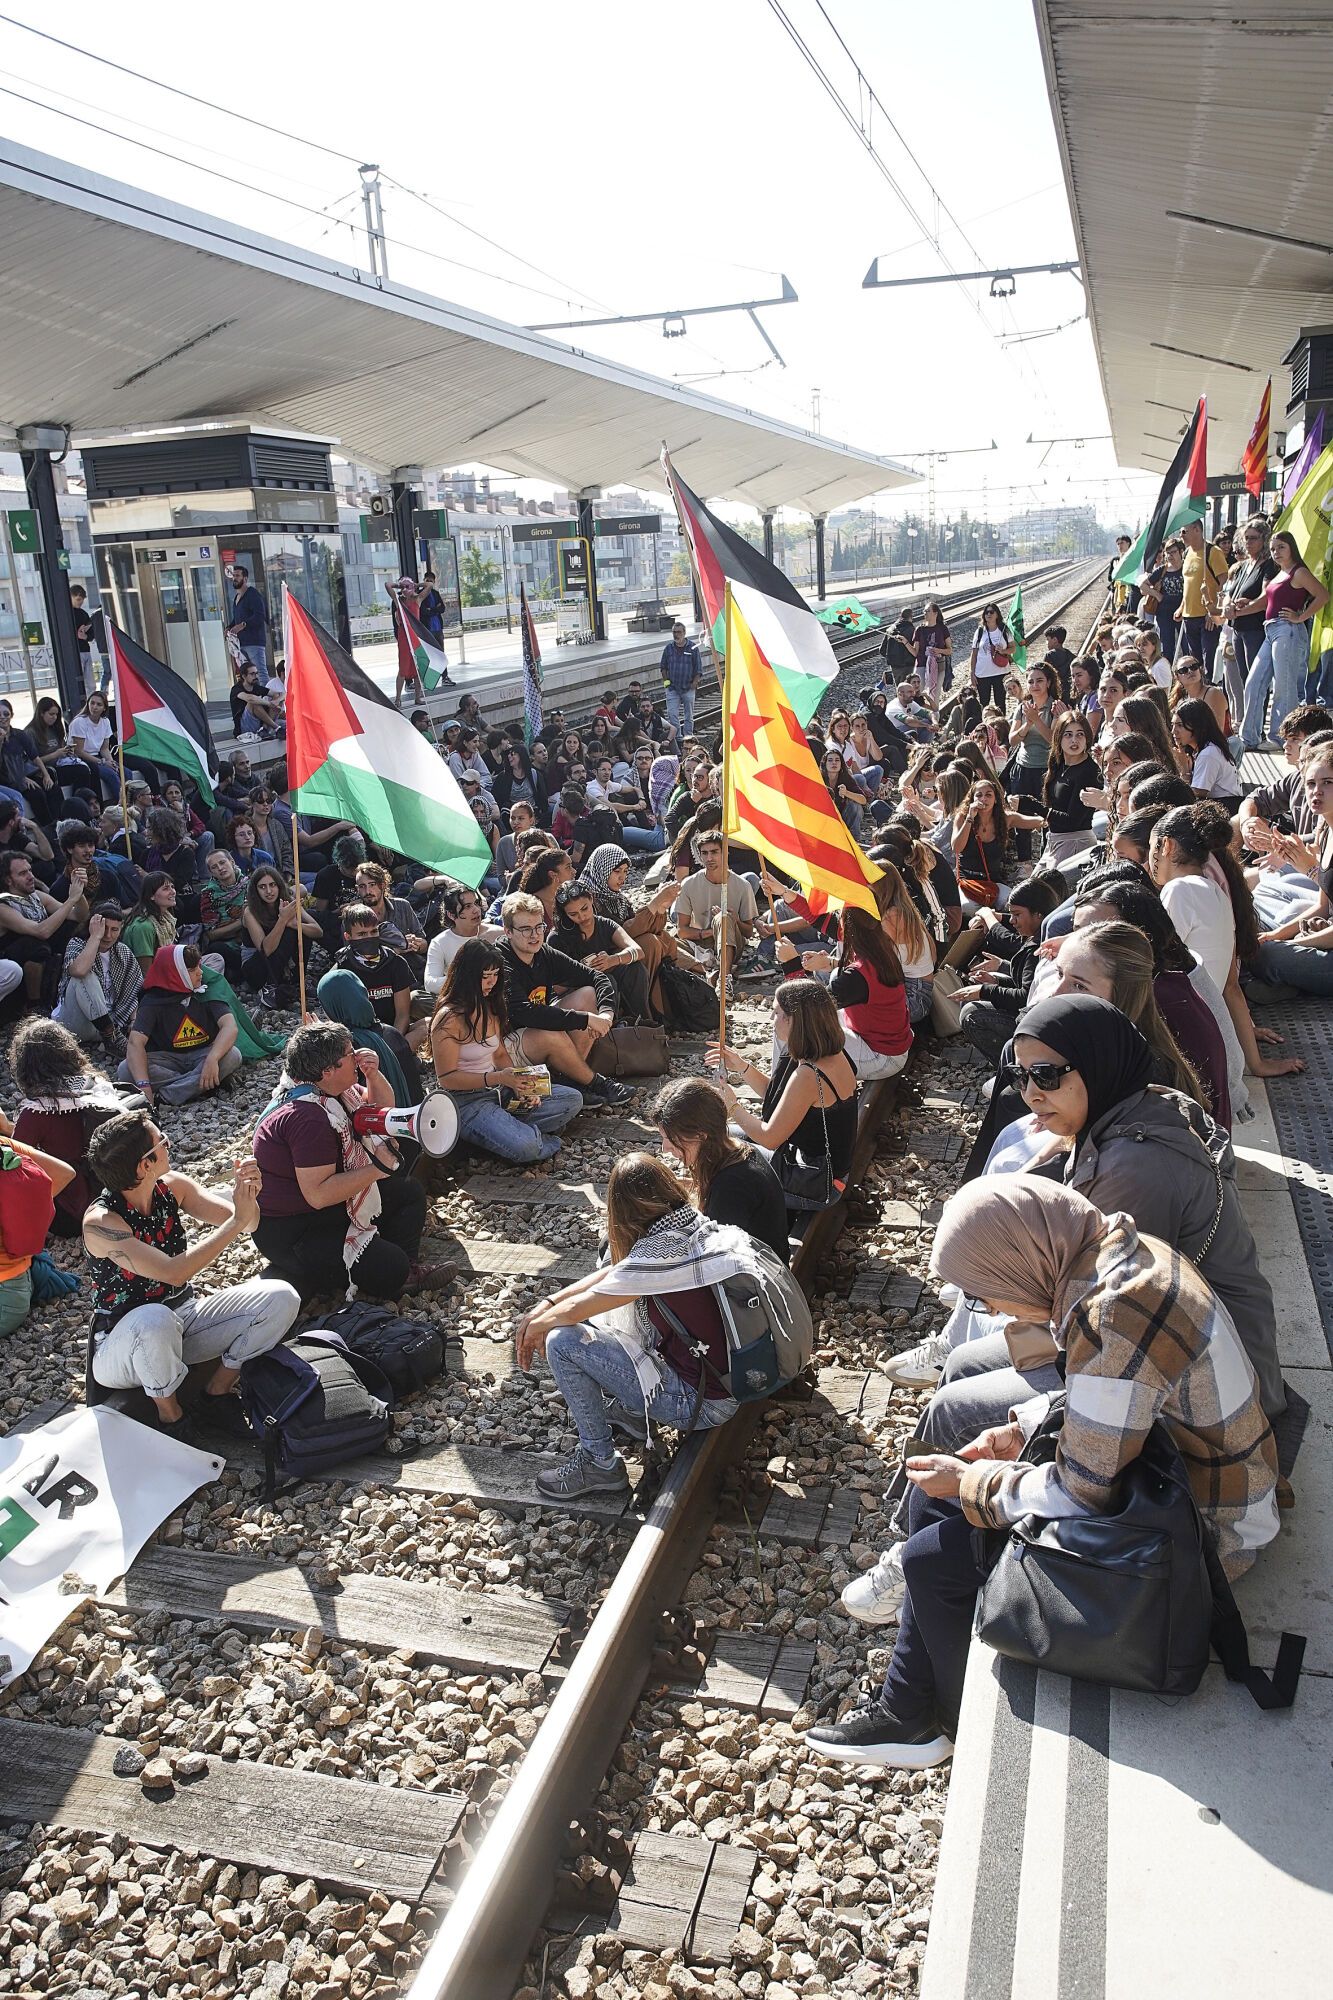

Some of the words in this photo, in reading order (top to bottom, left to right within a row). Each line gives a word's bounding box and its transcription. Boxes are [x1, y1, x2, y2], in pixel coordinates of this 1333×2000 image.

[618, 522, 641, 530] Girona
[383, 528, 391, 542] 3
[414, 526, 422, 540] 1
[530, 528, 553, 536] Girona
